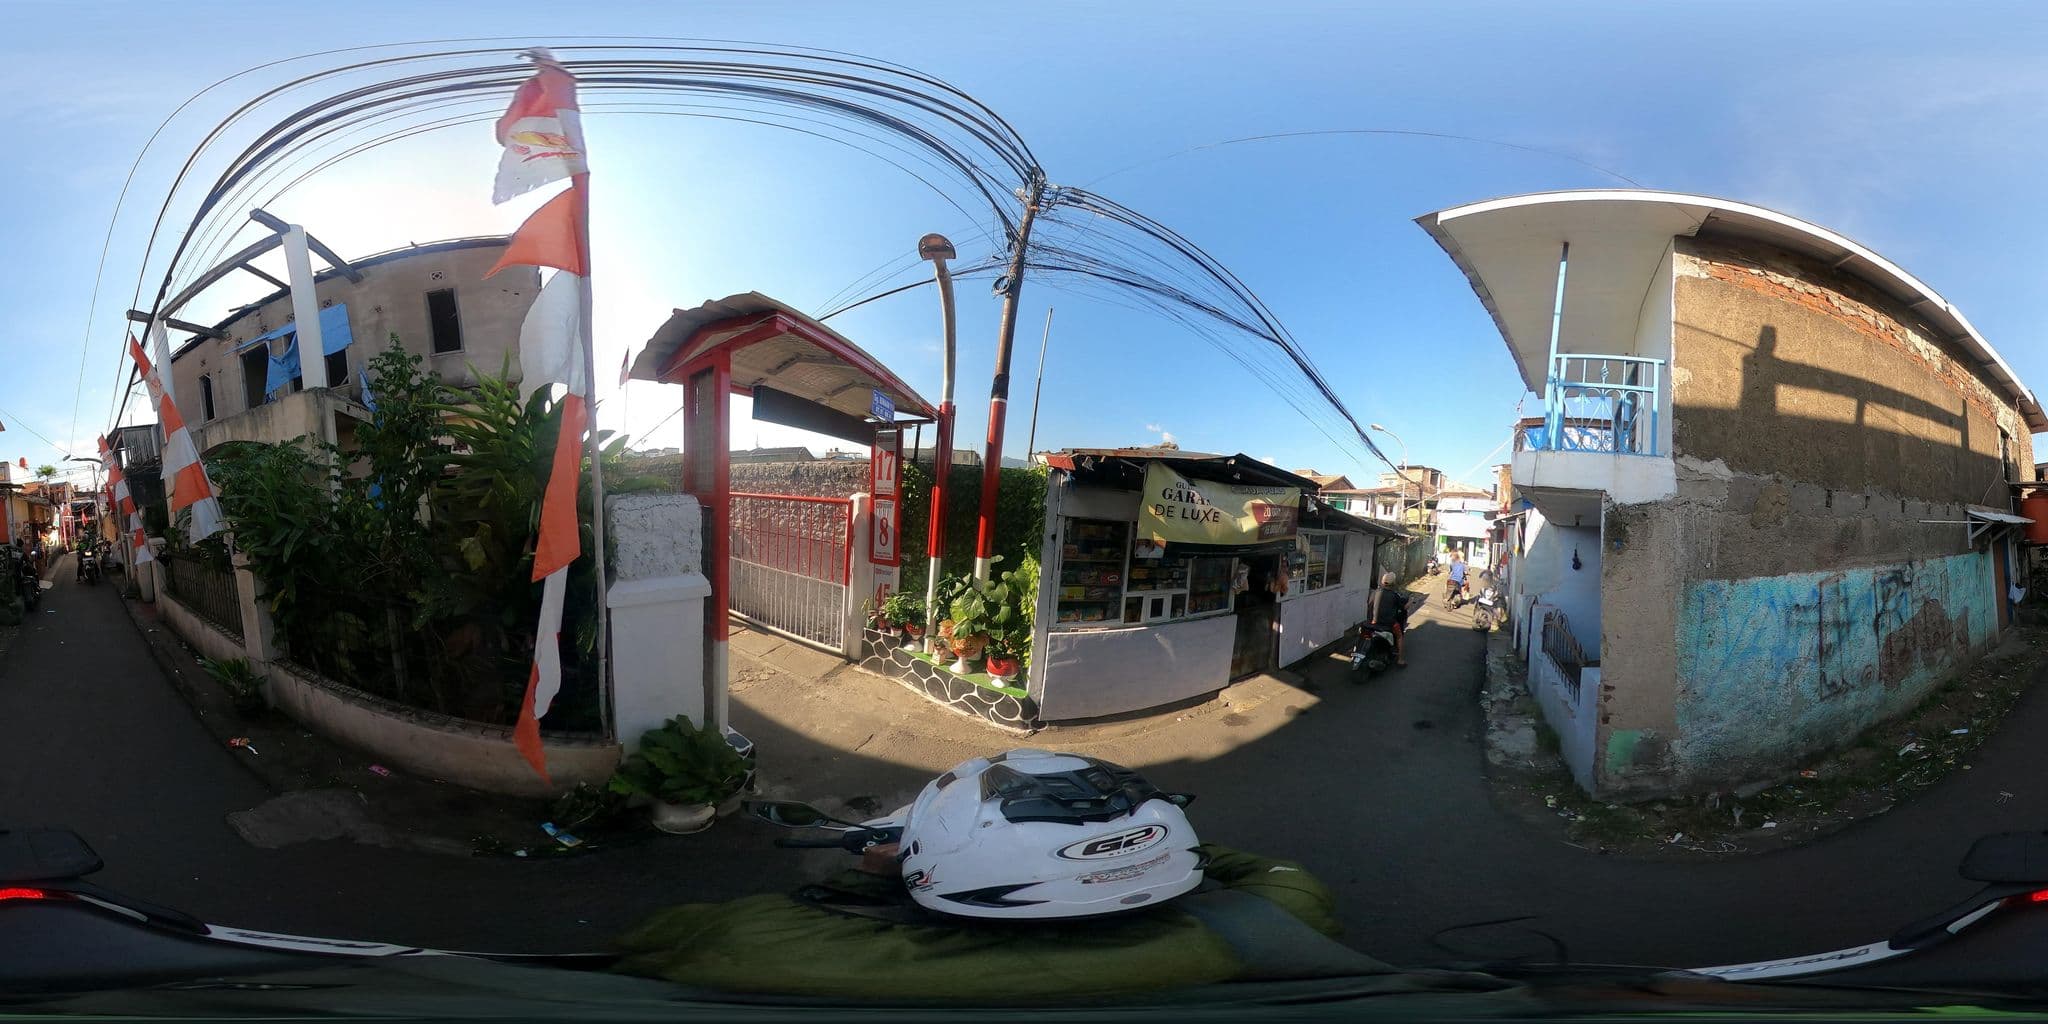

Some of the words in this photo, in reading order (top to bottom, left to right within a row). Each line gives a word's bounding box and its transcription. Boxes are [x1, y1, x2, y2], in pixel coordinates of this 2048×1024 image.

[877, 450, 894, 480] 17
[1162, 487, 1211, 506] GARA
[1155, 504, 1175, 518] DE
[1182, 507, 1220, 523] LUXE
[879, 517, 889, 546] 8
[1082, 827, 1158, 855] G2
